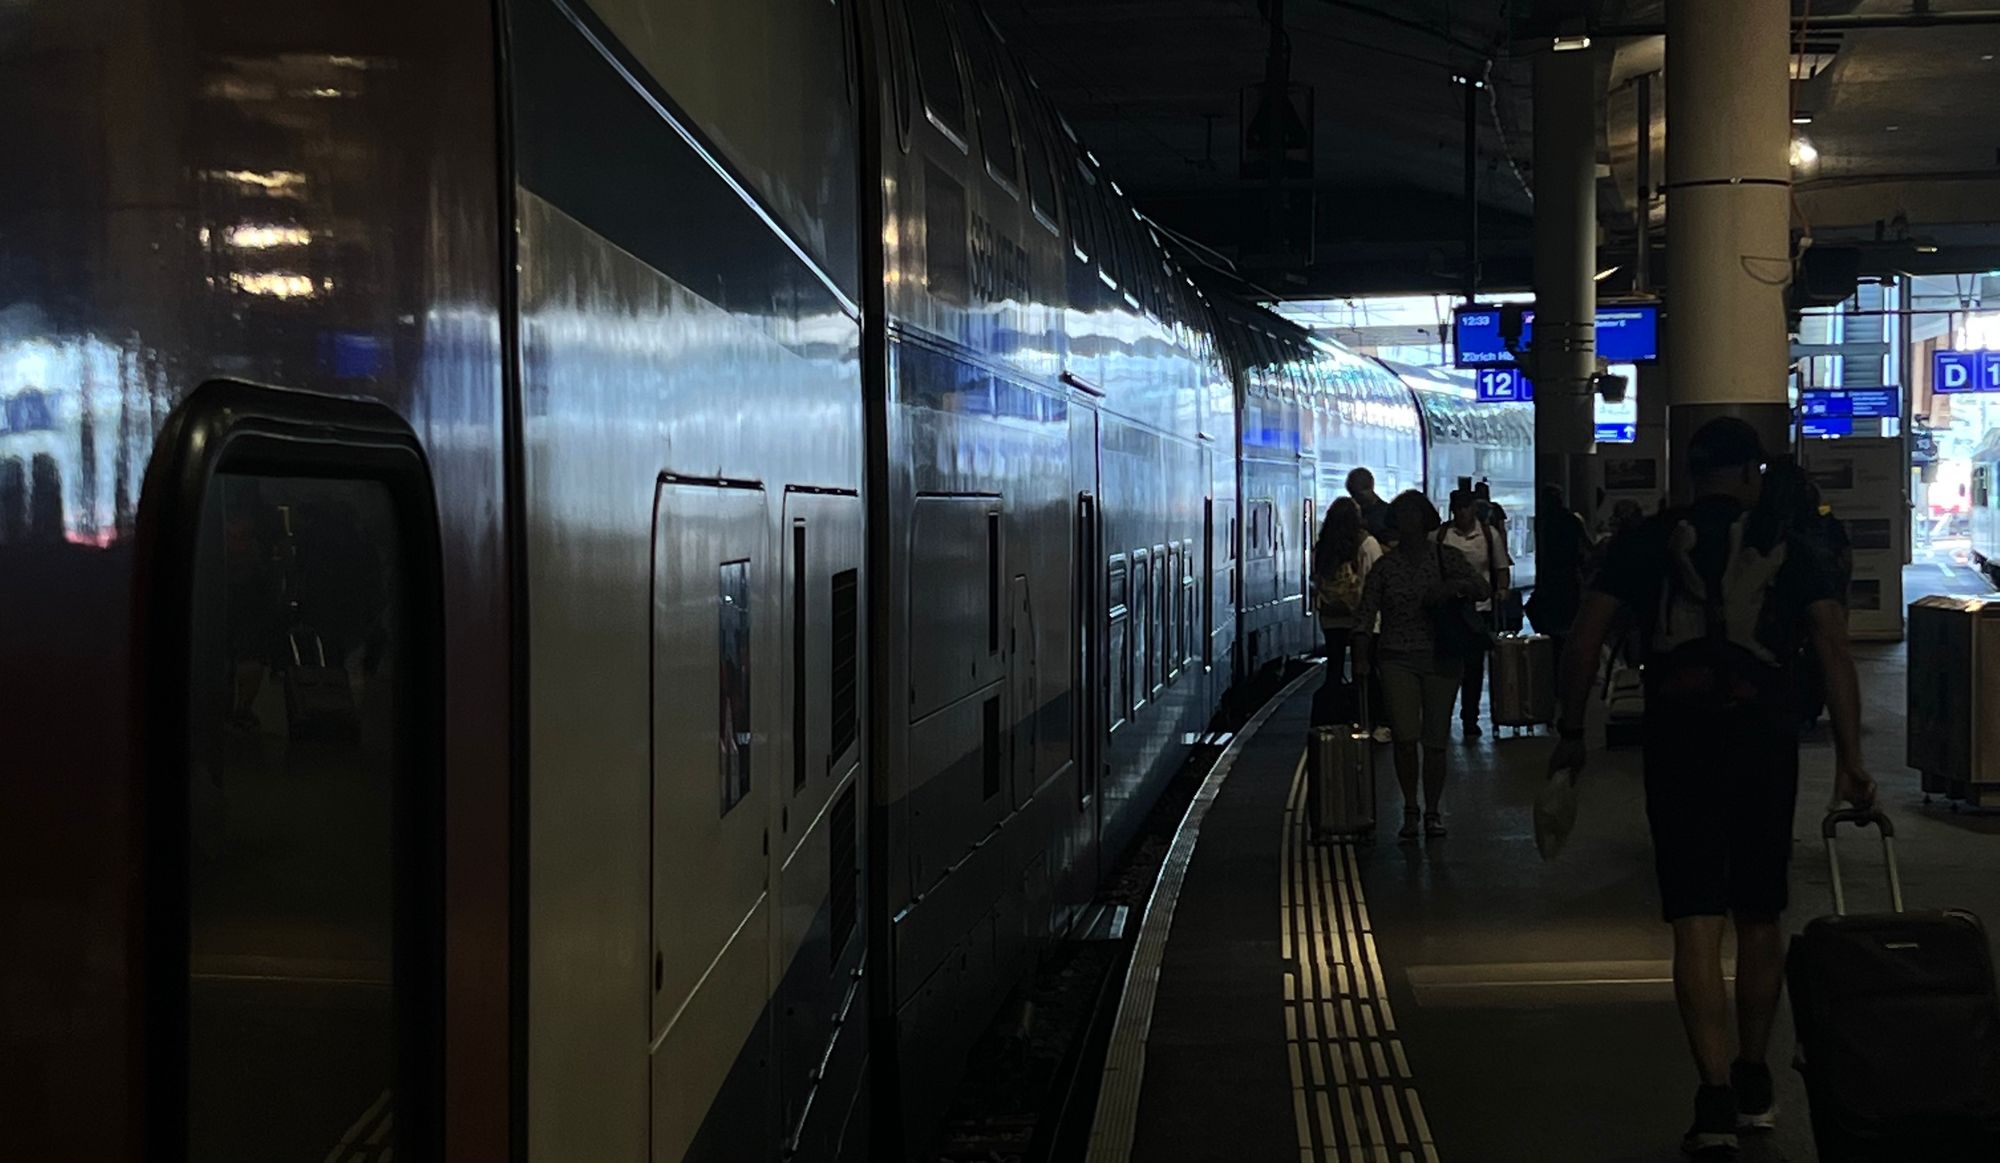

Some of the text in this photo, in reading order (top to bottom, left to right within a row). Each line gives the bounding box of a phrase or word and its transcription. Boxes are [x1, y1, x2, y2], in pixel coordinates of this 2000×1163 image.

[1462, 351, 1497, 362] Zürich
[1482, 372, 1512, 396] 12
[1944, 364, 1967, 387] D
